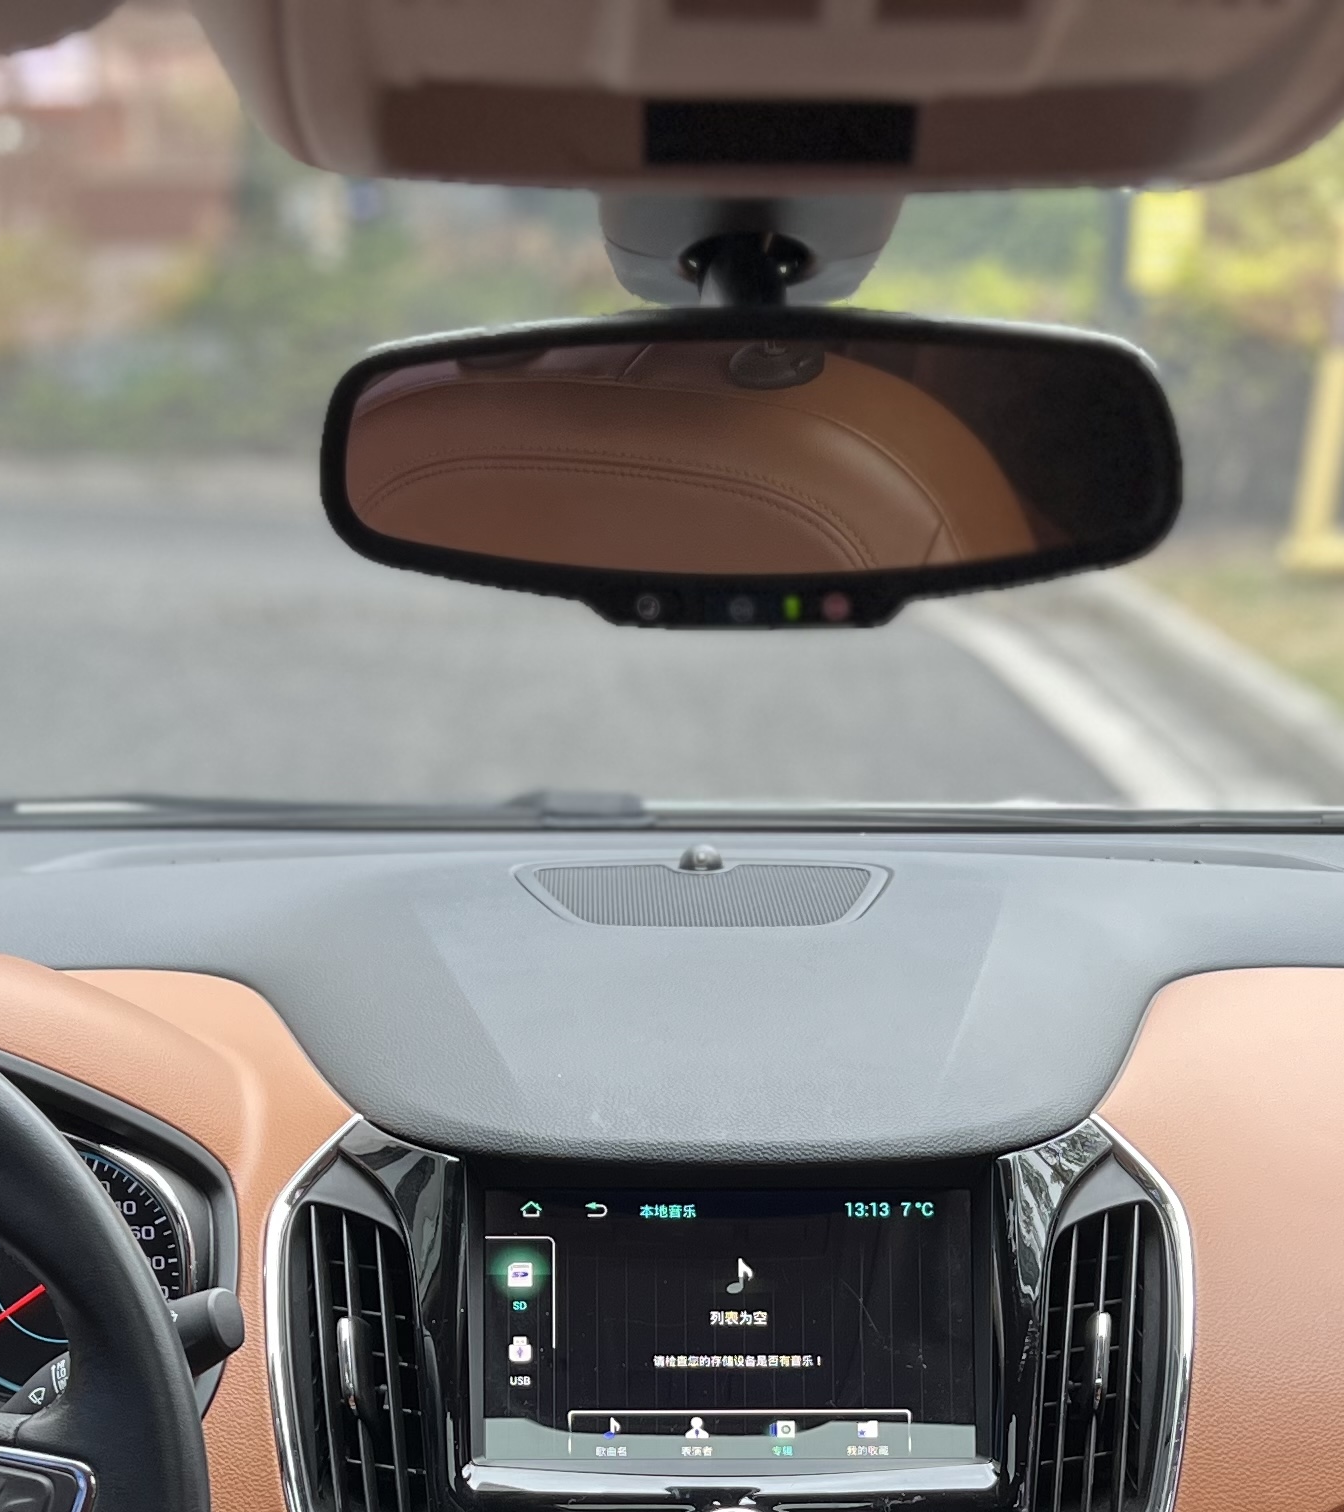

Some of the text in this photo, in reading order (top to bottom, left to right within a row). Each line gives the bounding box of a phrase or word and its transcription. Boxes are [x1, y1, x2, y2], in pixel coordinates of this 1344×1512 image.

[639, 1204, 697, 1218] 本地音乐
[845, 1202, 890, 1217] 13:13
[131, 1225, 155, 1240] 60
[512, 1301, 528, 1311] SD
[709, 1311, 768, 1325] 列表为空
[509, 1376, 531, 1386] USB
[595, 1446, 627, 1457] 歌曲名
[681, 1446, 713, 1457] 表演者
[772, 1446, 793, 1457] 专辑
[846, 1445, 889, 1457] 我的收藏
